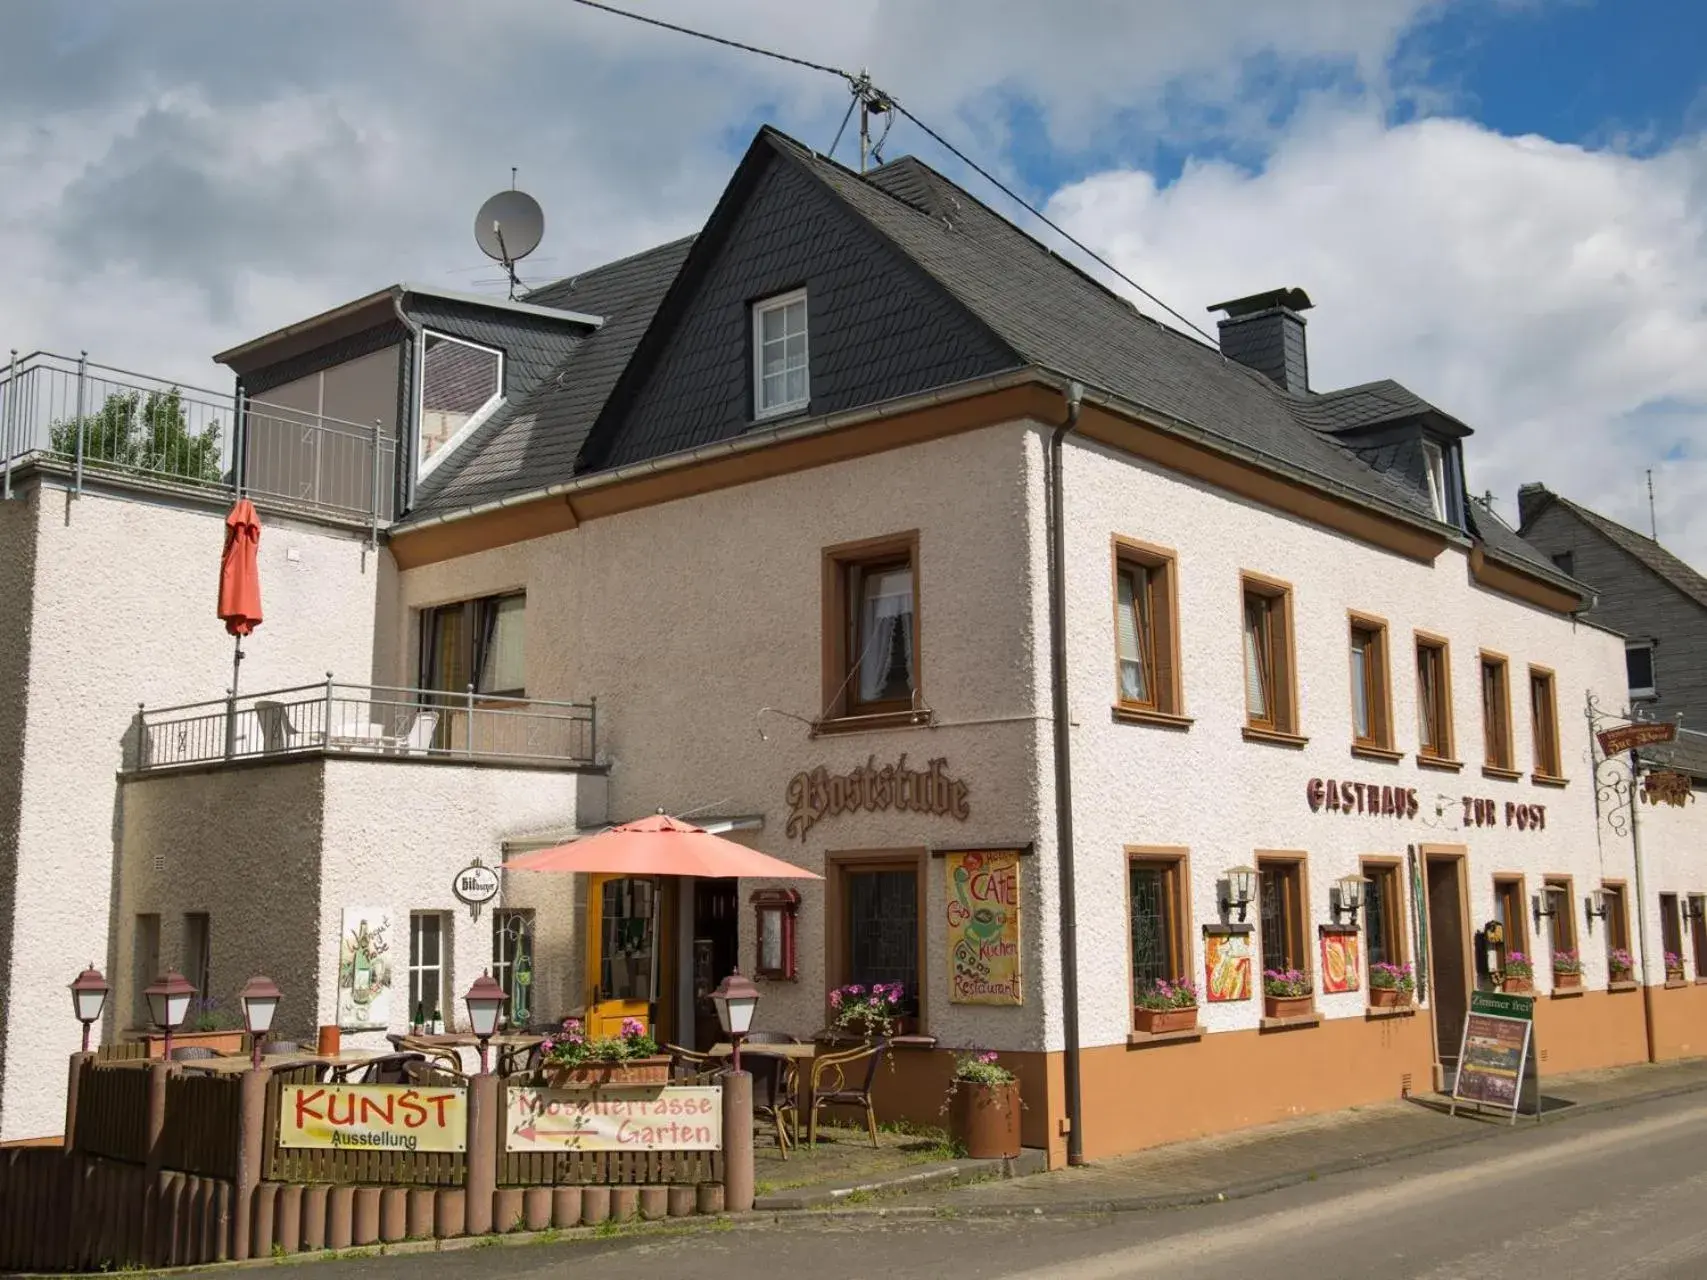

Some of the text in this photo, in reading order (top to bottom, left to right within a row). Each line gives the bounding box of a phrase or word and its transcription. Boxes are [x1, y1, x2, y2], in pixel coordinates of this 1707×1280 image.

[785, 752, 970, 844] Poststube
[1307, 778, 1547, 831] GASTHAUS ZUR POST
[953, 973, 1019, 999] Restaurant
[1472, 995, 1510, 1009] Zimmer
[296, 1089, 456, 1129] KUNST
[331, 1130, 417, 1150] Ausstellung
[615, 1118, 711, 1144] Garten
